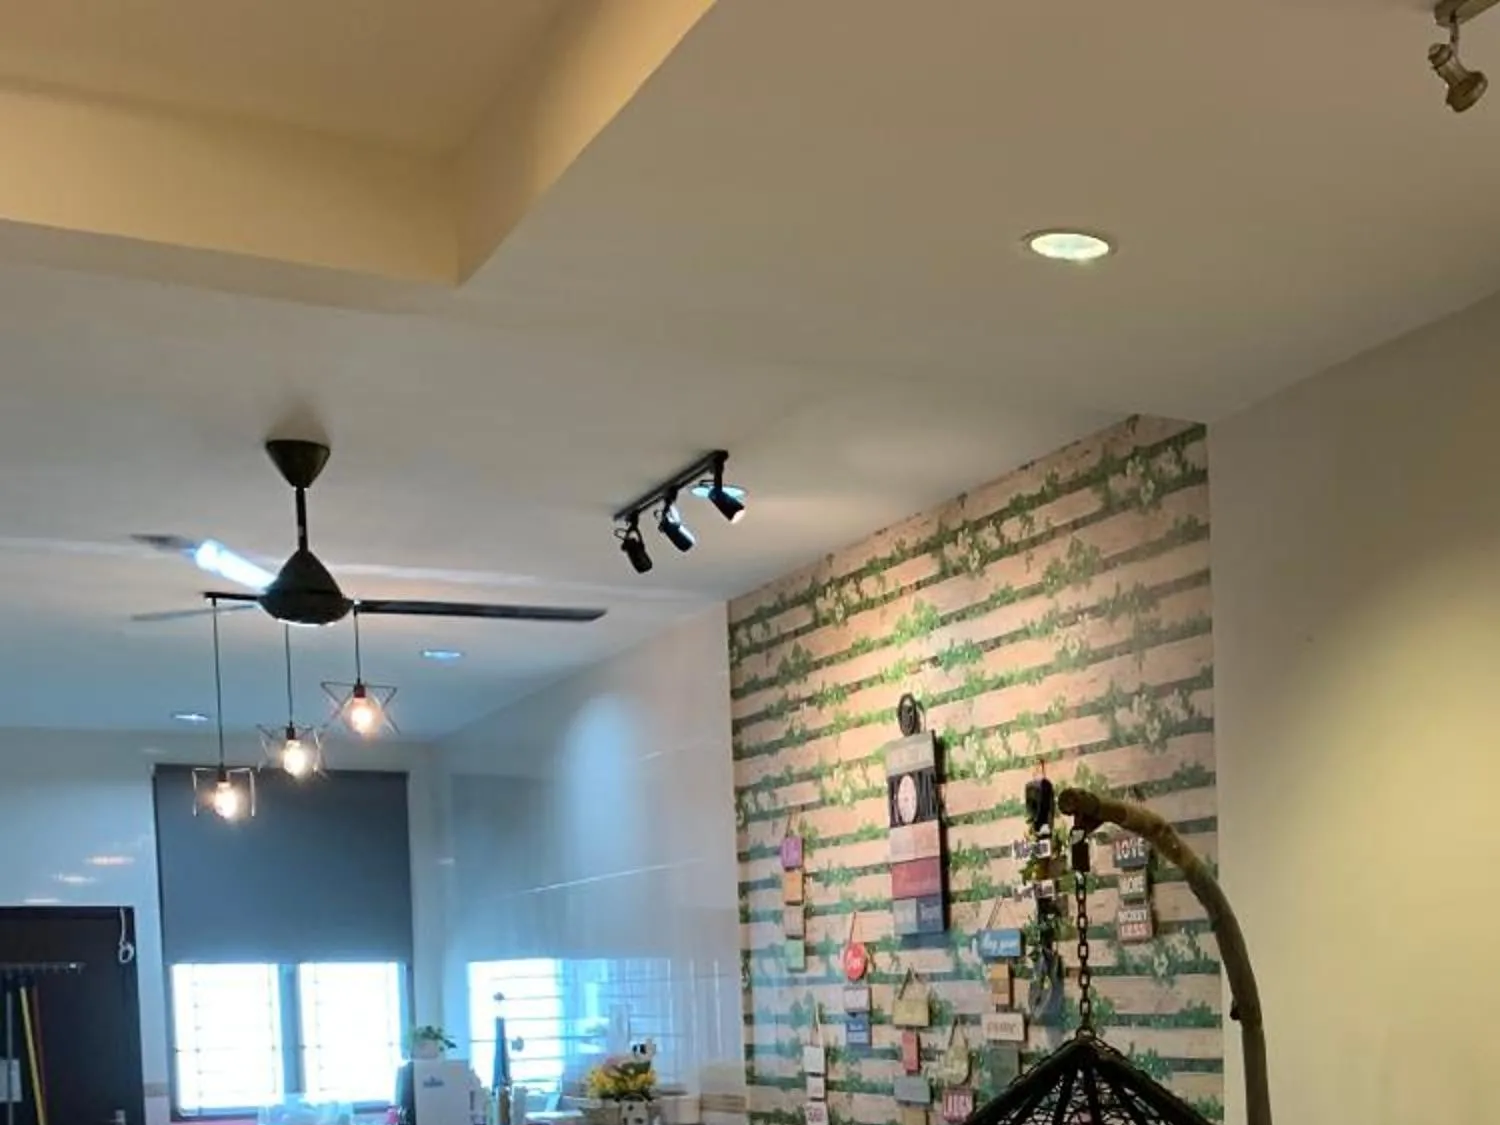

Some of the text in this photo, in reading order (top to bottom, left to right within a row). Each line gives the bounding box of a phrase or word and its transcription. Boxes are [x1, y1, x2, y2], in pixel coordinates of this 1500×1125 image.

[1115, 837, 1145, 860] LOVE
[1119, 875, 1145, 893] MORE
[1121, 923, 1148, 937] LESS
